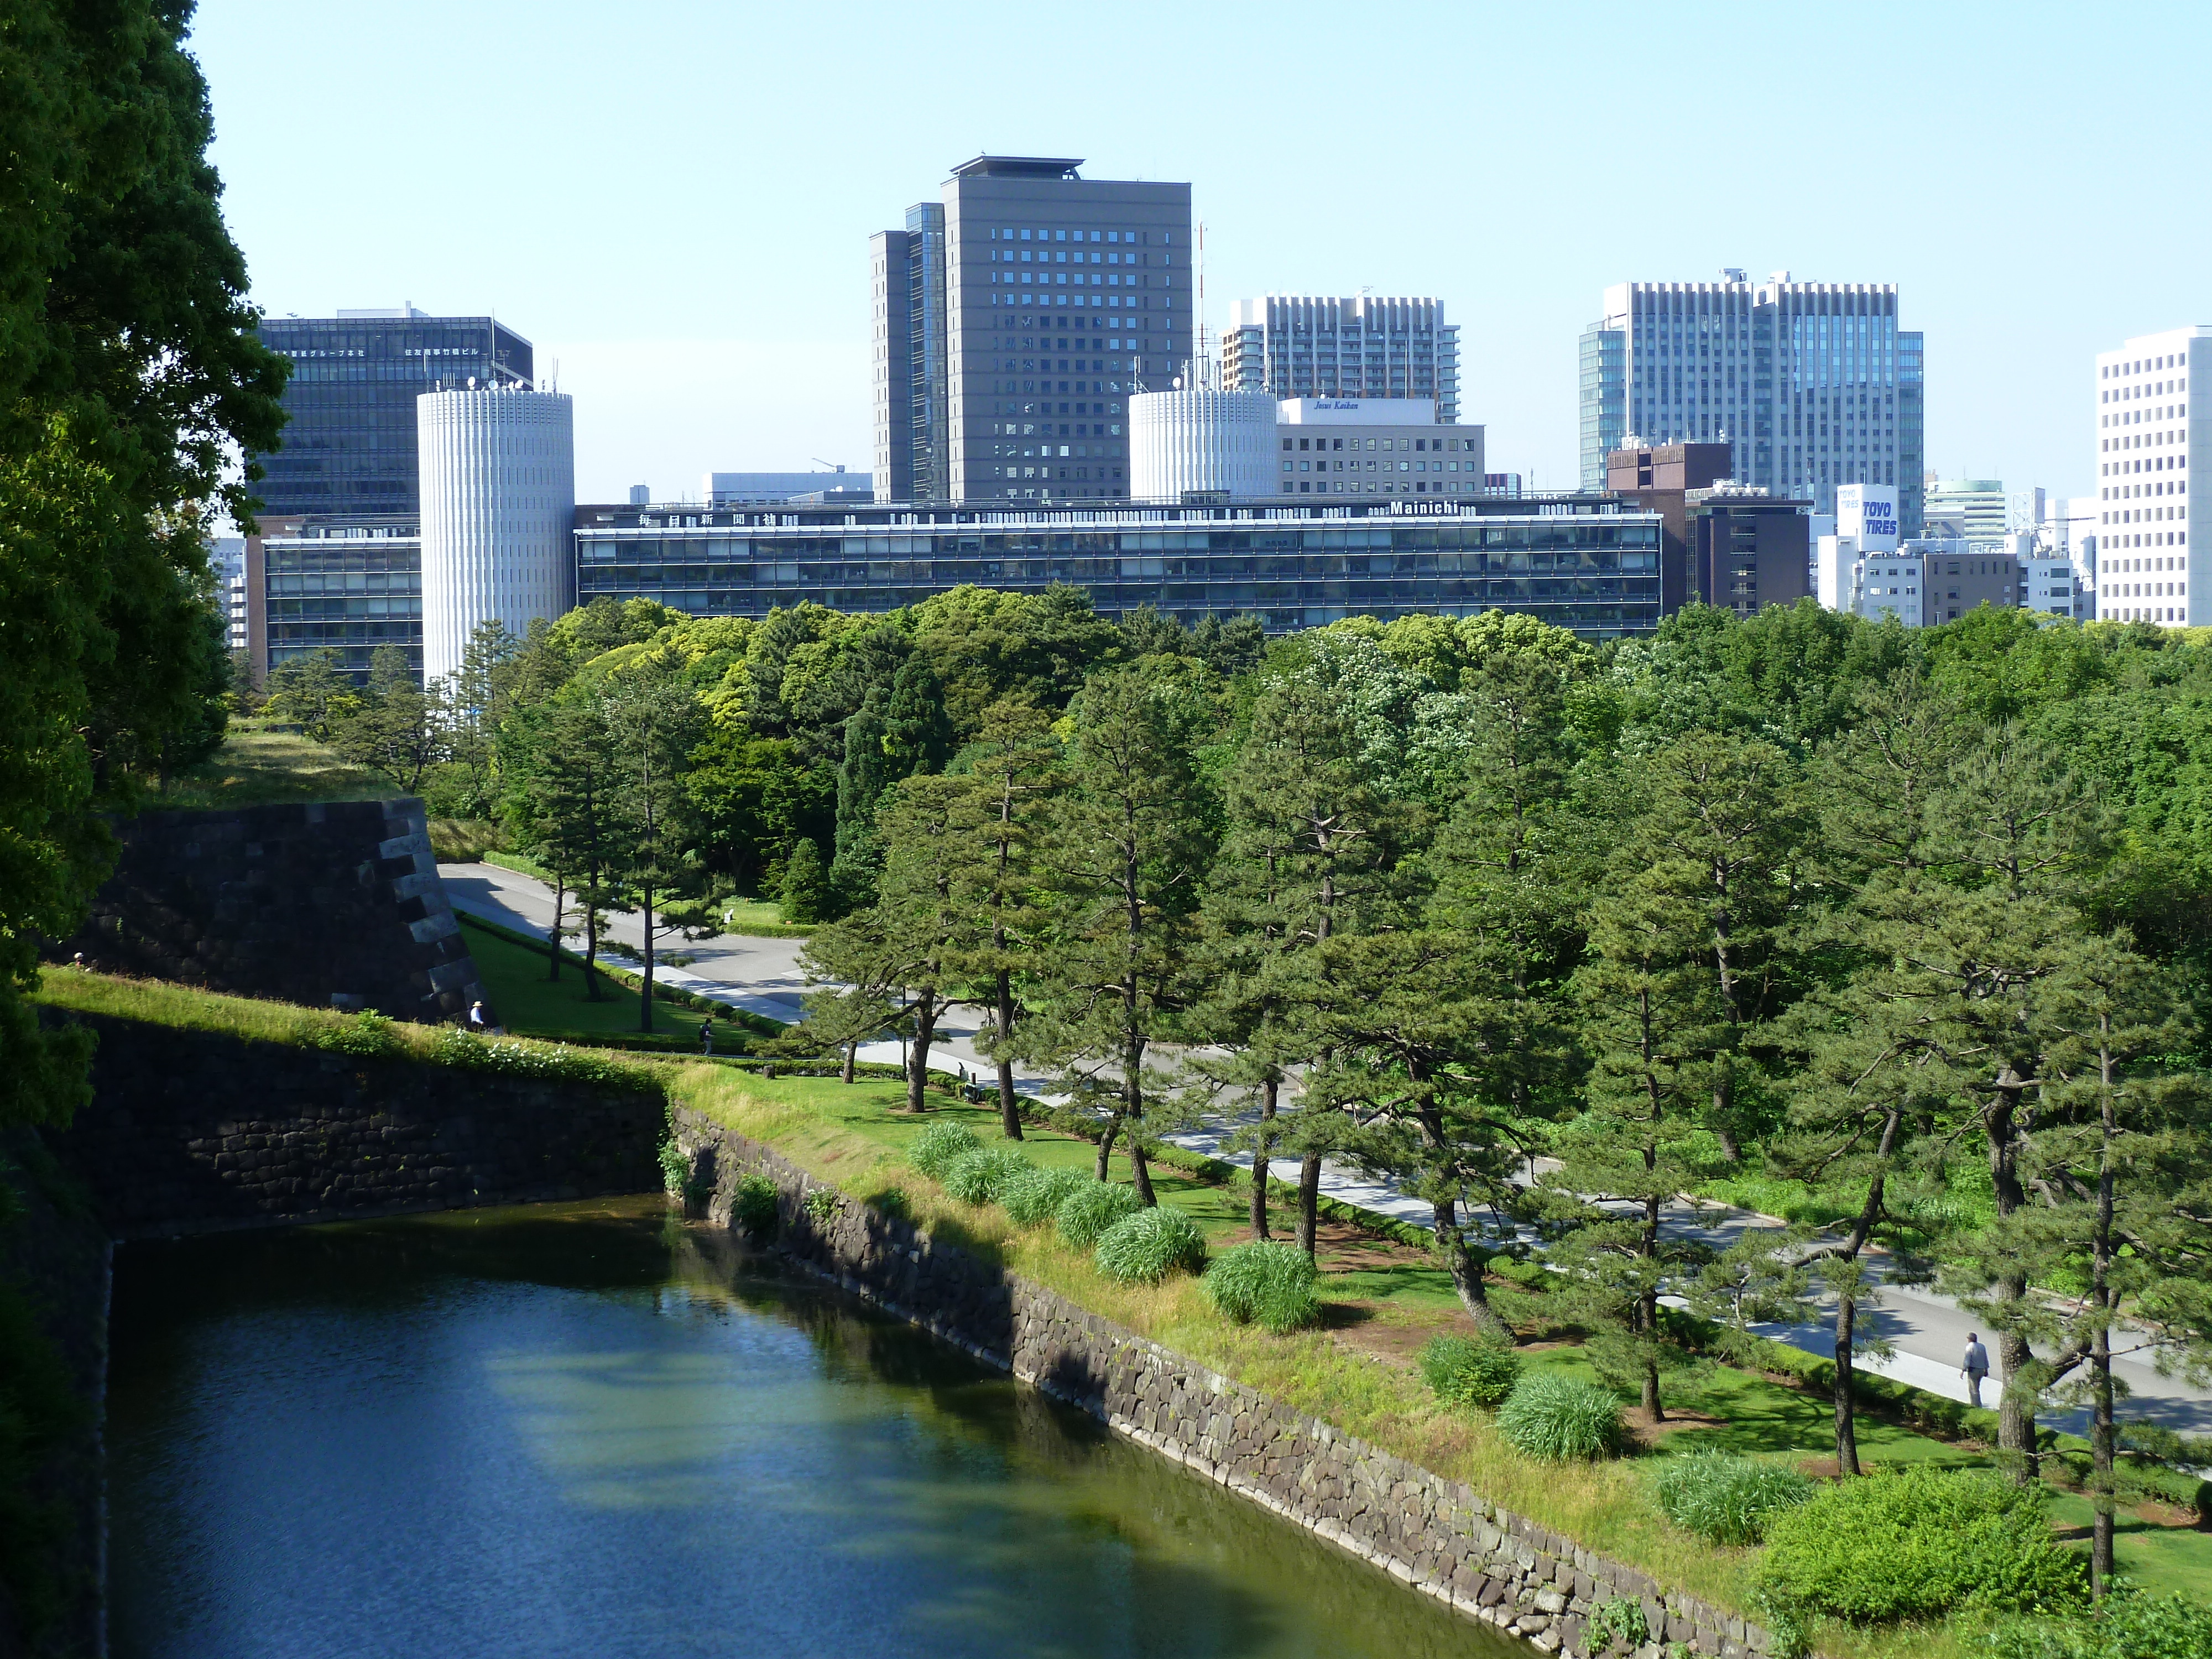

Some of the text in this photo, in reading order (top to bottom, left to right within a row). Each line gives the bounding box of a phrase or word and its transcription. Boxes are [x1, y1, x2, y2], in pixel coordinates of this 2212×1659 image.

[1334, 400, 1359, 410] Kaikan
[1839, 489, 1855, 498] TOYO
[1390, 500, 1458, 515] Mainichi
[1841, 500, 1859, 508] TIRES
[1863, 501, 1891, 517] TOYO
[1865, 519, 1897, 535] TIRES
